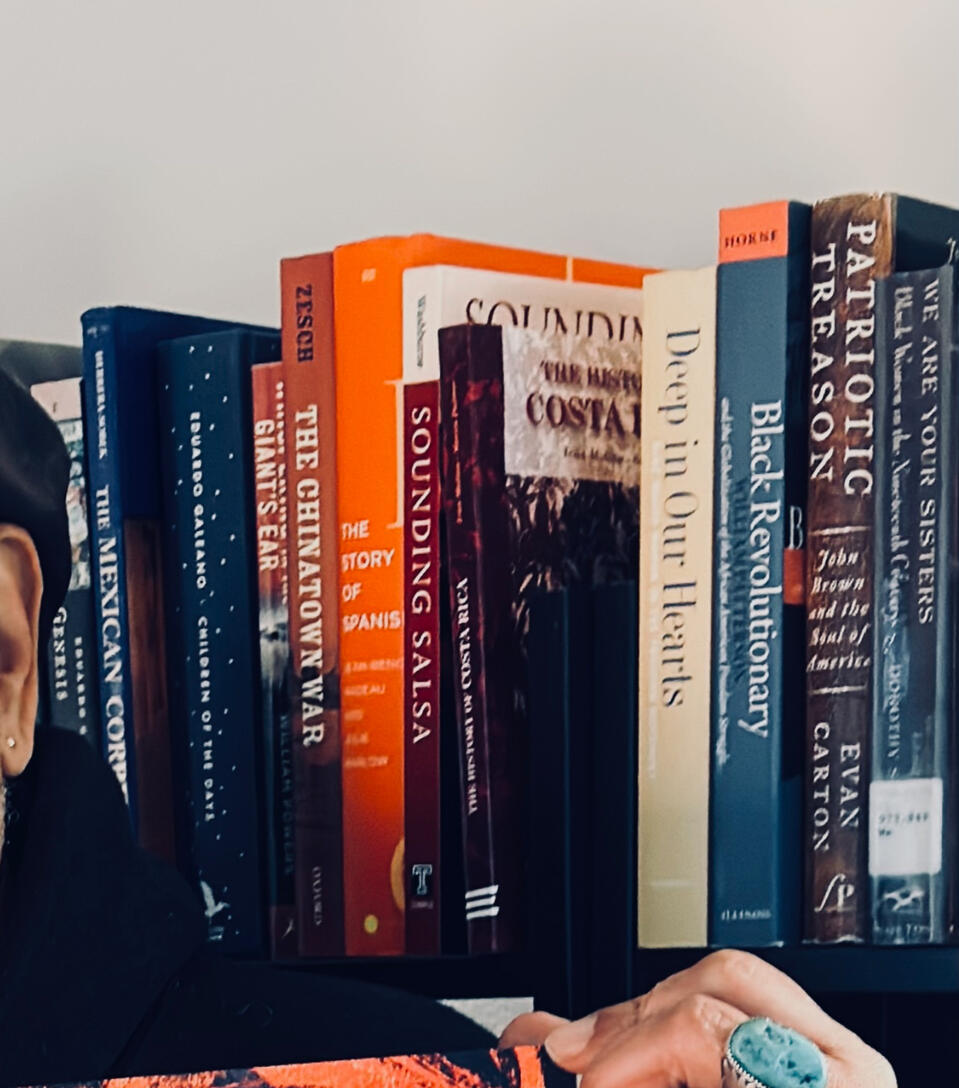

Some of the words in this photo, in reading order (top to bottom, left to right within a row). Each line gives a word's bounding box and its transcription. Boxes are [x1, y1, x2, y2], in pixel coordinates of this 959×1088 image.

[724, 228, 779, 249] HORNE
[295, 283, 313, 363] ZESCH
[922, 278, 940, 322] WE
[658, 328, 701, 426] Deep
[810, 243, 836, 482] TREASON
[844, 220, 877, 495] PATRIOTIC
[921, 336, 939, 395] ARE
[294, 404, 319, 470] THE
[527, 391, 627, 440] COSTA
[750, 400, 785, 495] Black
[920, 405, 938, 487] YOUR
[190, 411, 205, 497] EDUARDO
[254, 418, 279, 516] GIANT'S
[664, 437, 699, 478] in
[95, 484, 111, 531] THE
[341, 519, 369, 539] THE
[411, 406, 432, 614] SOUNDING
[663, 491, 698, 567] Our
[193, 504, 208, 590] GALEANO
[258, 524, 279, 572] EAR
[296, 478, 323, 669] CHINATOWN
[342, 548, 395, 572] STORY
[817, 548, 859, 573] John
[917, 499, 936, 625] SISTERS
[98, 537, 123, 683] MEXICAN
[342, 582, 361, 602] OF
[342, 610, 404, 633] SPANIS
[455, 577, 470, 626] RICA
[737, 499, 784, 738] Revolutionary
[808, 600, 838, 621] and
[841, 599, 870, 617] the
[810, 575, 865, 596] Brown
[52, 606, 69, 701] GENESIS
[197, 615, 211, 703] CHILDREN
[458, 629, 473, 690] COSTA
[662, 581, 698, 708] Hearts
[806, 653, 872, 673] America
[809, 625, 845, 647] Soul
[849, 623, 872, 647] of
[73, 636, 87, 719] EDUARDO
[301, 675, 325, 747] WAR
[411, 631, 433, 744] SALSA
[201, 710, 214, 732] OF
[202, 740, 215, 771] THE
[280, 714, 293, 795] WILLIAM
[203, 779, 216, 823] DAYS
[813, 721, 831, 853] CARTON
[840, 742, 861, 828] EVAN
[412, 864, 433, 895] T
